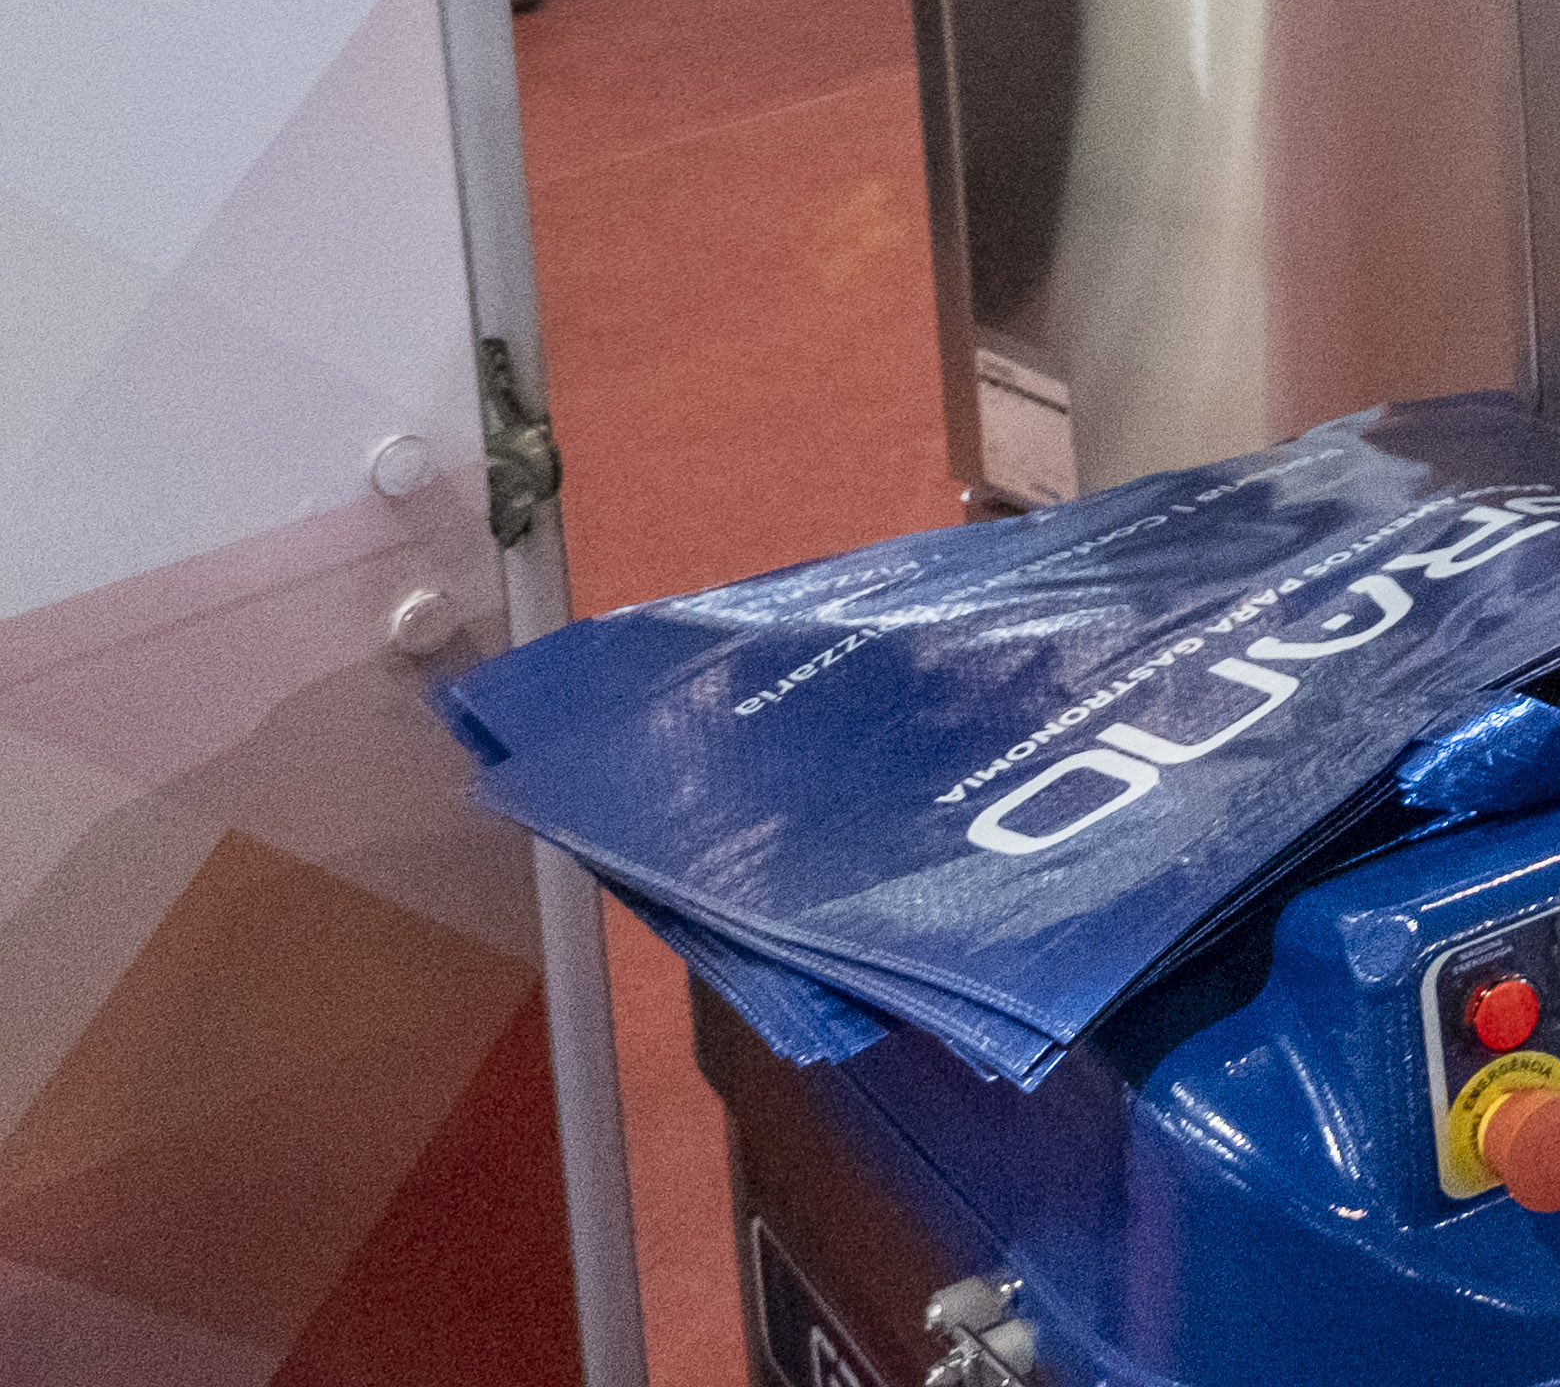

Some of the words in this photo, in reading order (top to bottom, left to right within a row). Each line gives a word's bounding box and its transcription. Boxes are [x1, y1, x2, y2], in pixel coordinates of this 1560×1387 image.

[1204, 576, 1304, 635] PARA
[933, 634, 1205, 807] GASTRONOMIA
[1462, 1055, 1555, 1112] EMERGÊNCIA
